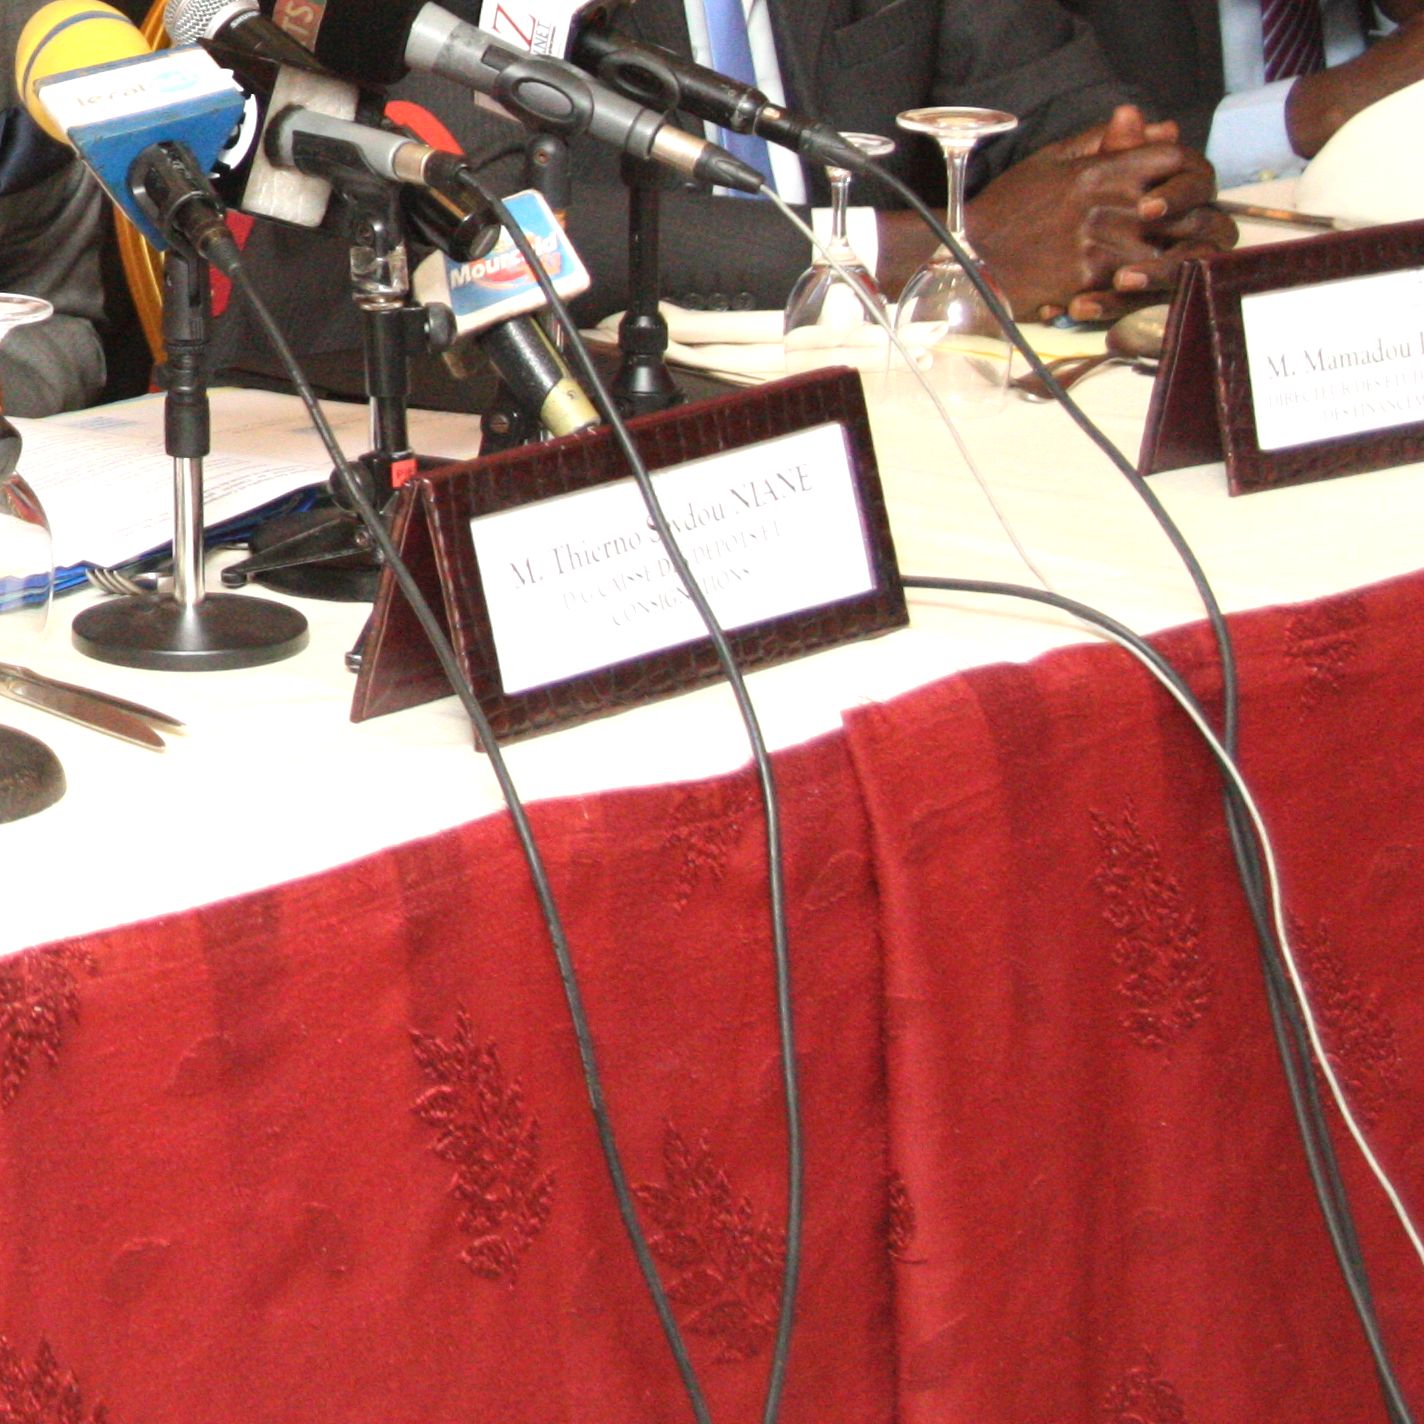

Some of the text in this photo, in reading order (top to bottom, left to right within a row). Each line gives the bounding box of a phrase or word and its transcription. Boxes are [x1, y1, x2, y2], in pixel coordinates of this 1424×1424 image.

[1266, 353, 1296, 380] M.
[1302, 336, 1412, 373] Mamadou
[509, 556, 544, 589] M.
[552, 531, 642, 575] Thierno
[728, 463, 814, 515] NIANE
[610, 568, 752, 627] CONSIGNTIONS
